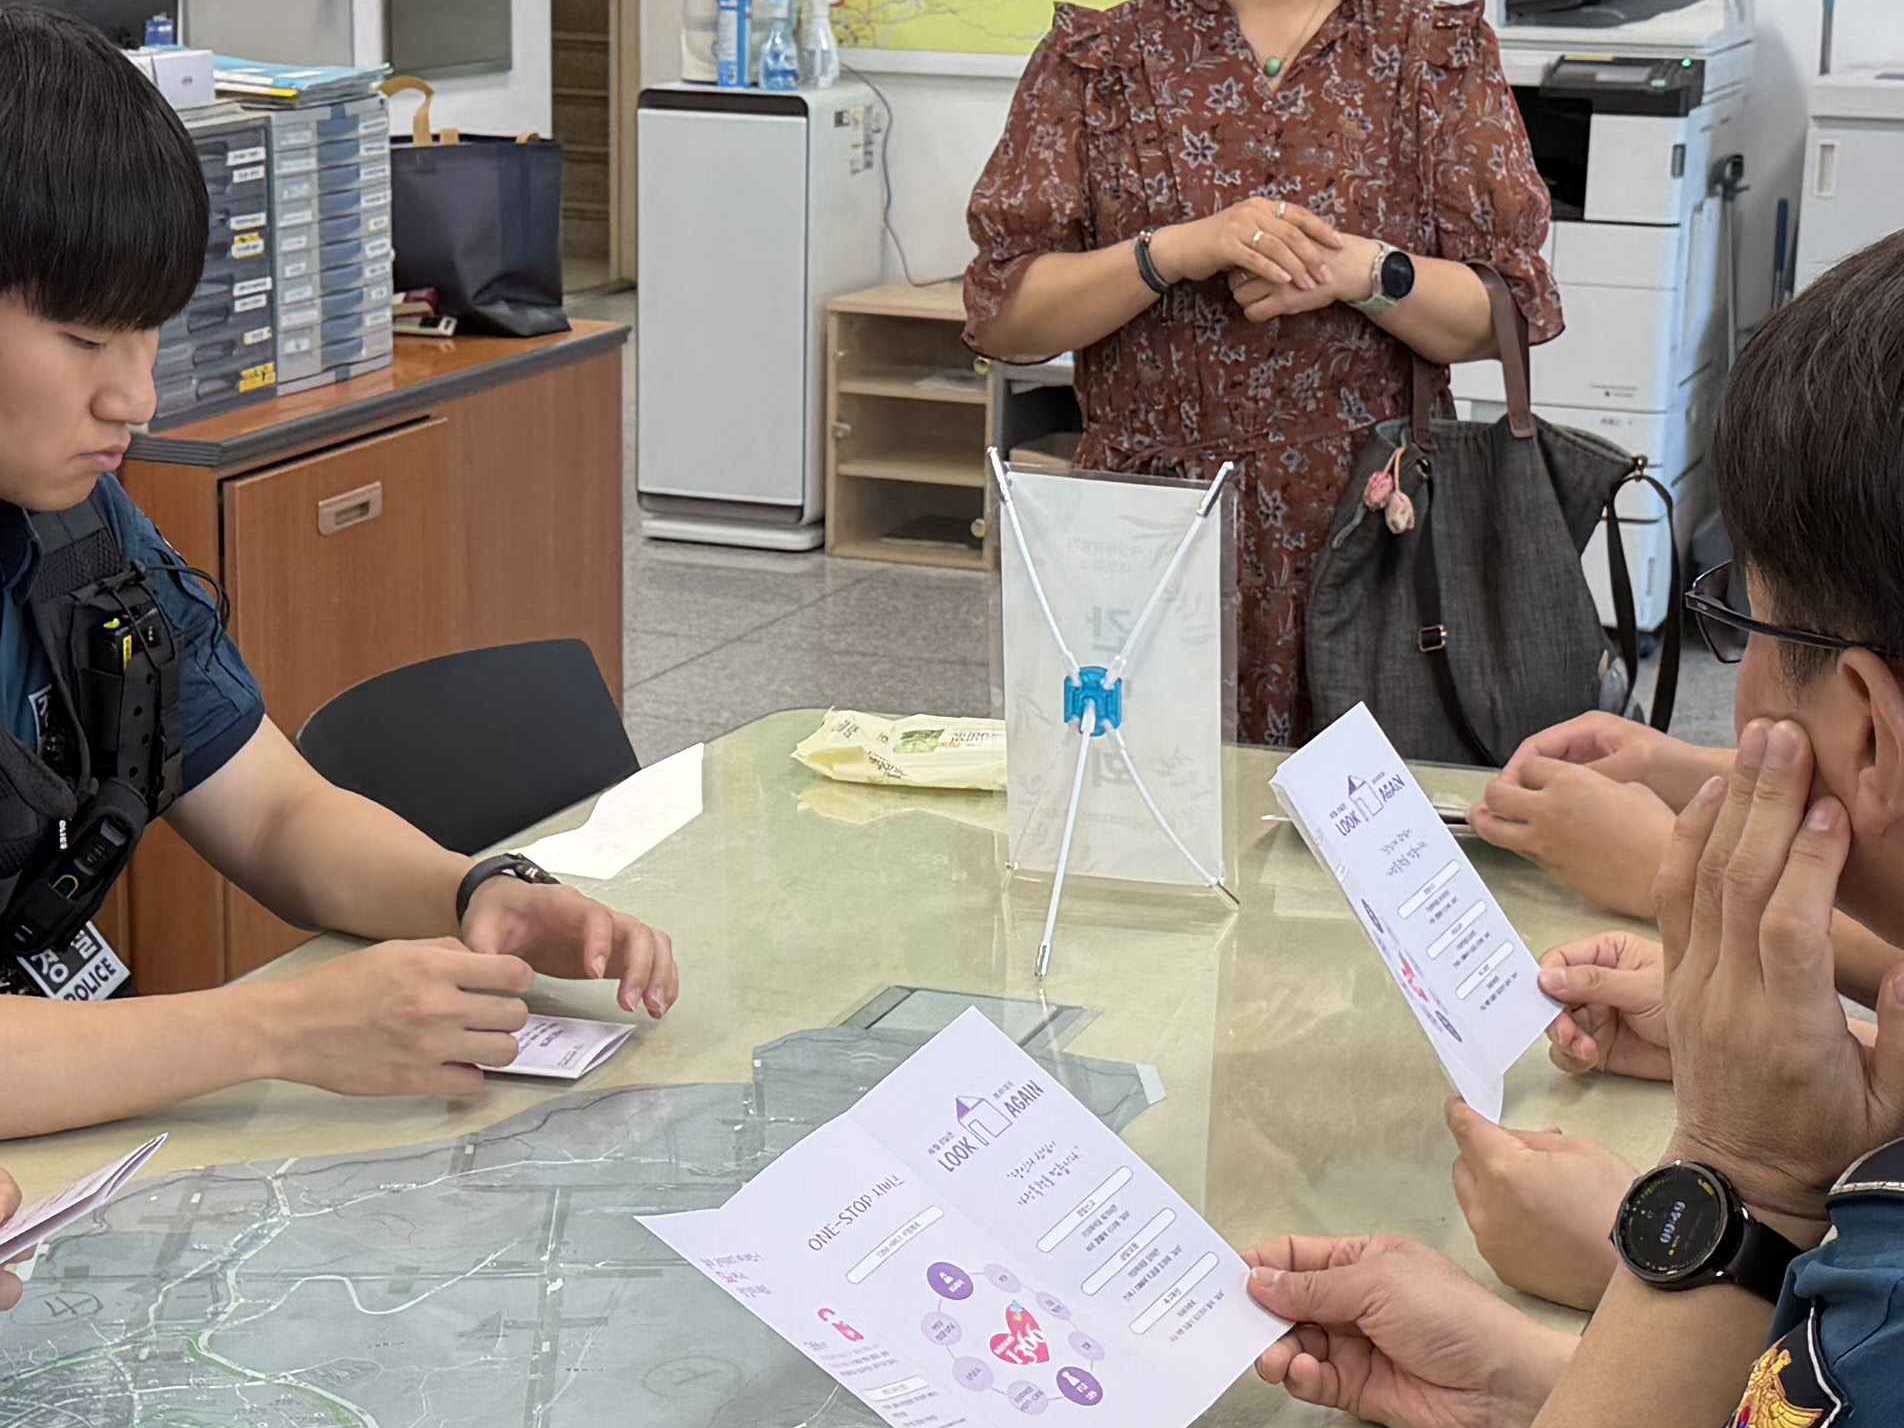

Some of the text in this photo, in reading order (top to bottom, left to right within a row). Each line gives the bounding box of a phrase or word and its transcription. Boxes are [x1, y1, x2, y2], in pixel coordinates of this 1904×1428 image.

[1335, 810, 1361, 836] LOOK
[1003, 1080, 1044, 1118] AGAIN
[938, 1137, 978, 1172] LOOK
[808, 1194, 873, 1252] ONE-STOP
[1005, 1323, 1046, 1365] 1366
